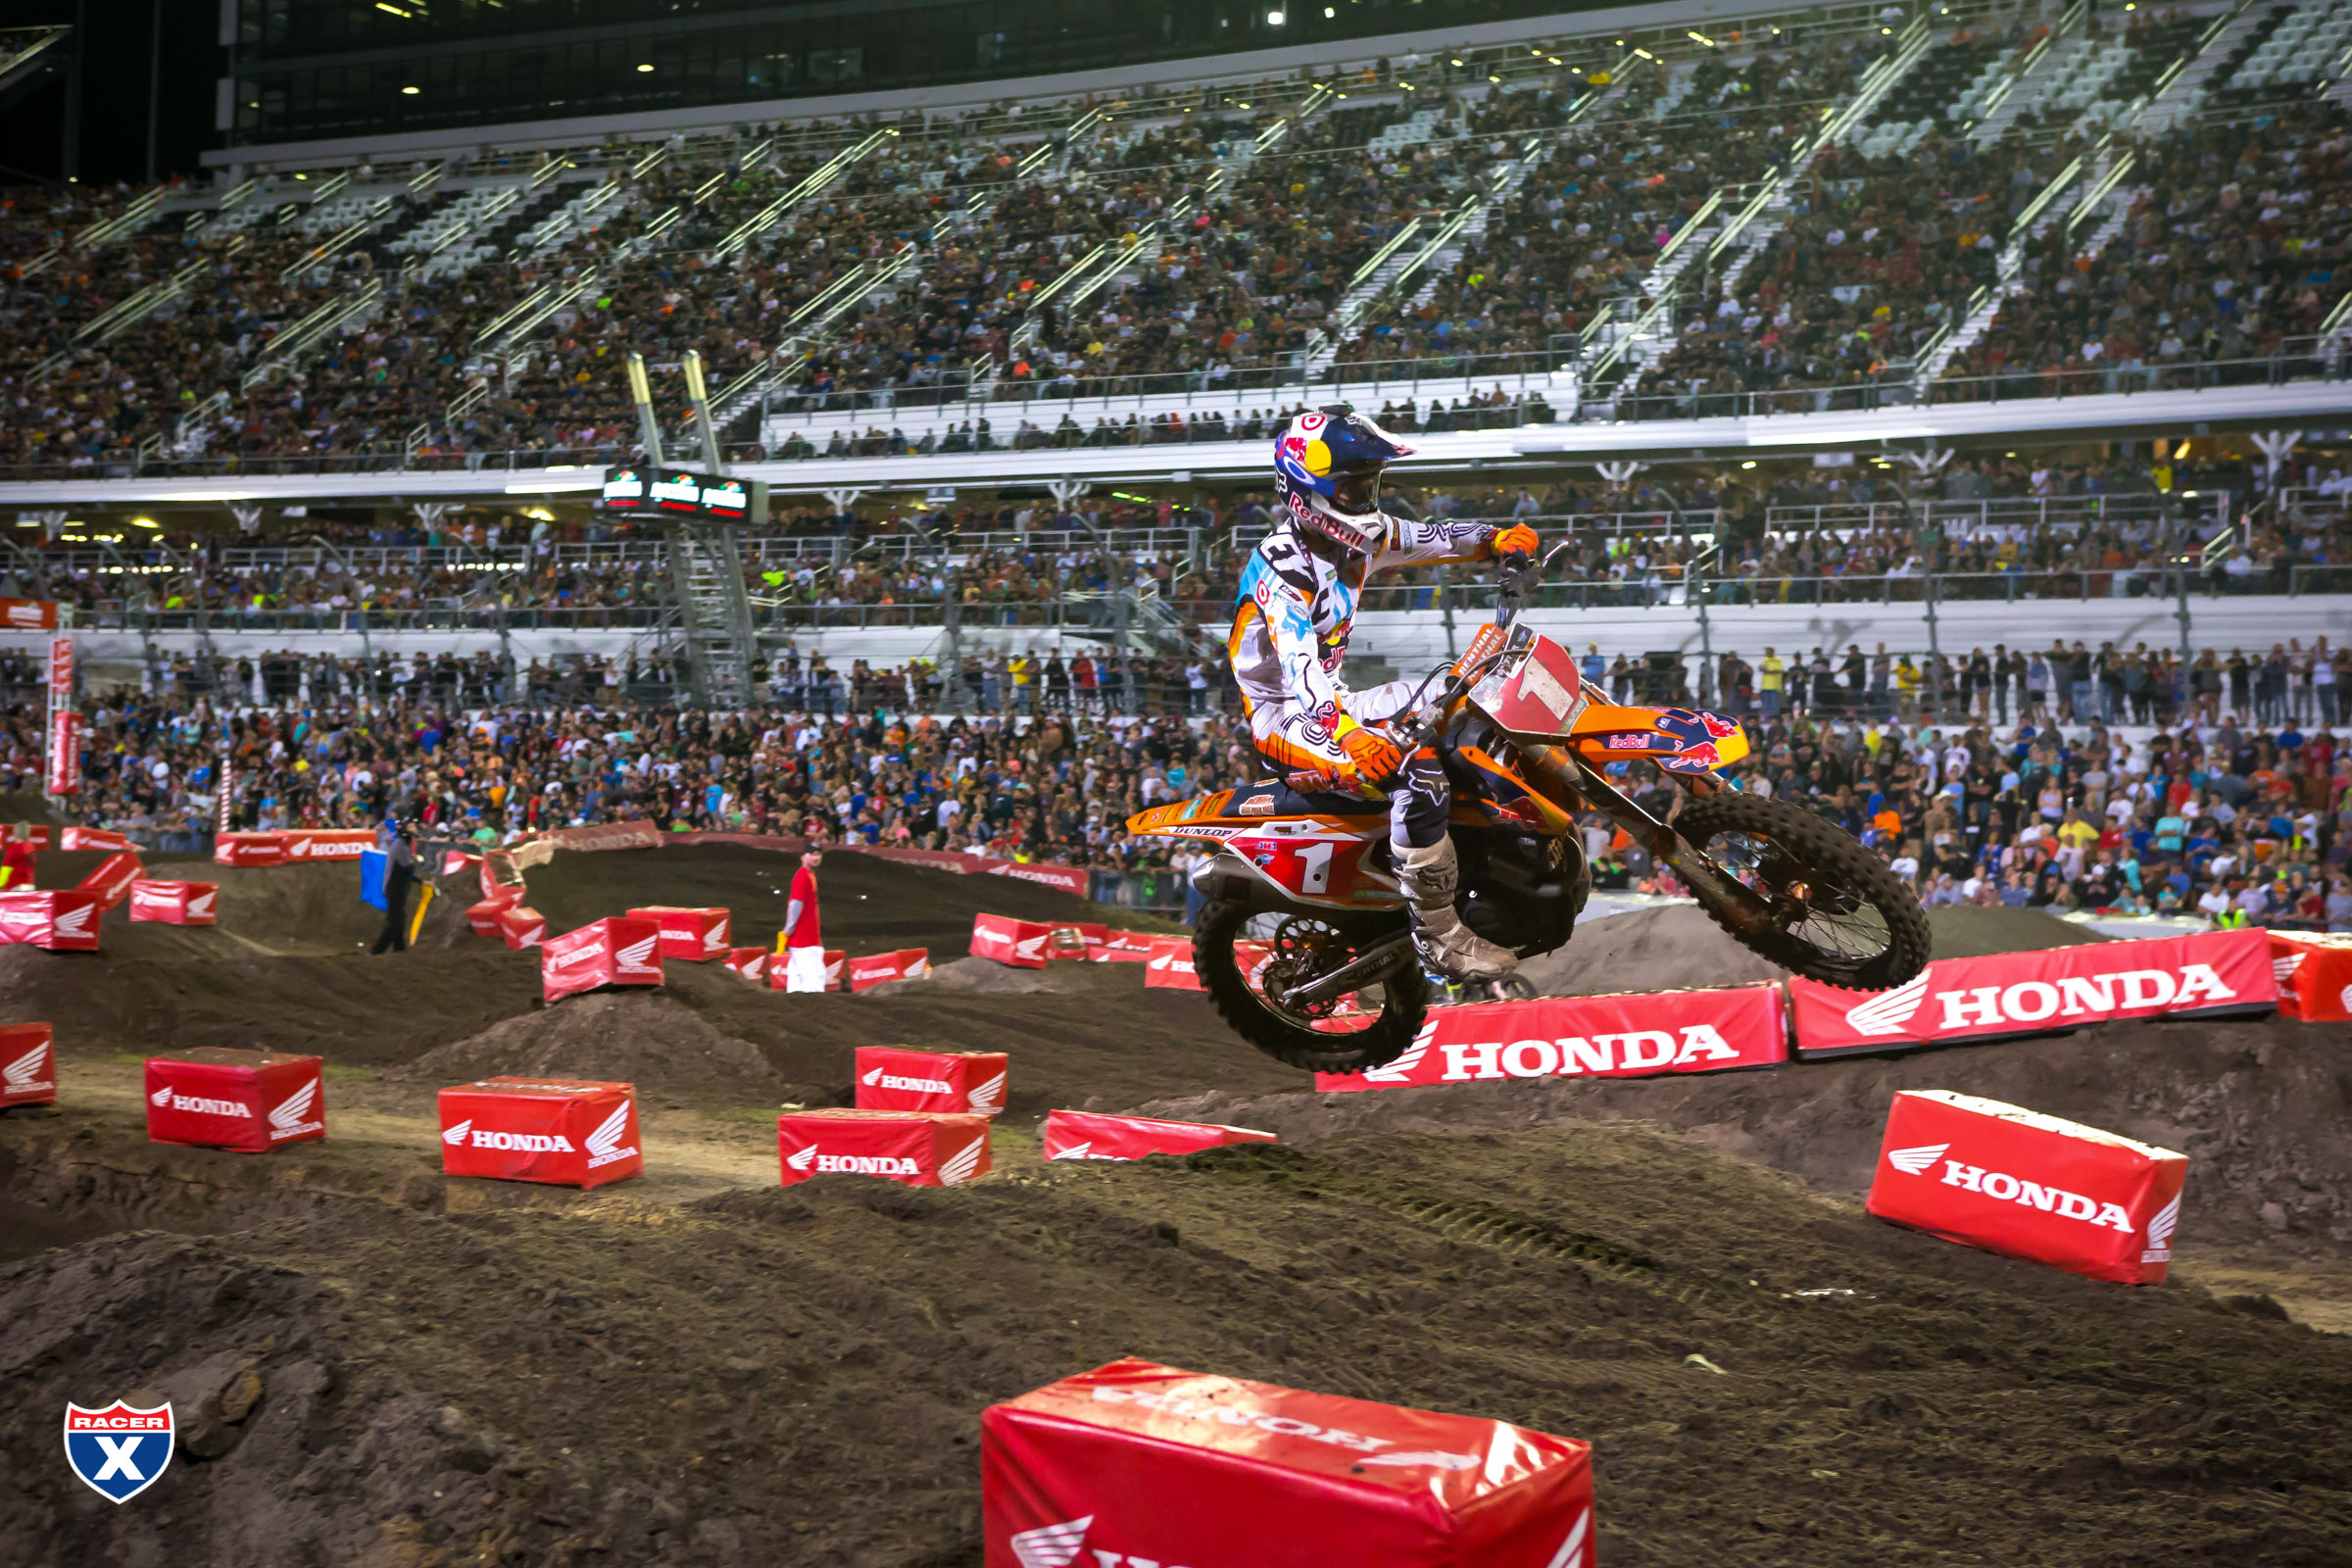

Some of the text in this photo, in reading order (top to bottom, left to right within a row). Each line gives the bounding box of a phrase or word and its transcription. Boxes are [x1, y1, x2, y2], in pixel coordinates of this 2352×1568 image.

[1458, 626, 1495, 676] RENTHAL
[1517, 655, 1575, 721] 1
[1173, 826, 1233, 837] DUNLOP
[1009, 869, 1076, 888] HONDA
[1294, 842, 1334, 894] 1
[1936, 963, 2237, 1030] HONDA
[1440, 1024, 1740, 1081] HONDA
[880, 1075, 954, 1095] HONDA
[172, 1095, 253, 1118] HONDA
[470, 1130, 576, 1153] HONDA
[816, 1154, 921, 1176] HONDA
[1940, 1159, 2135, 1234] HONDA
